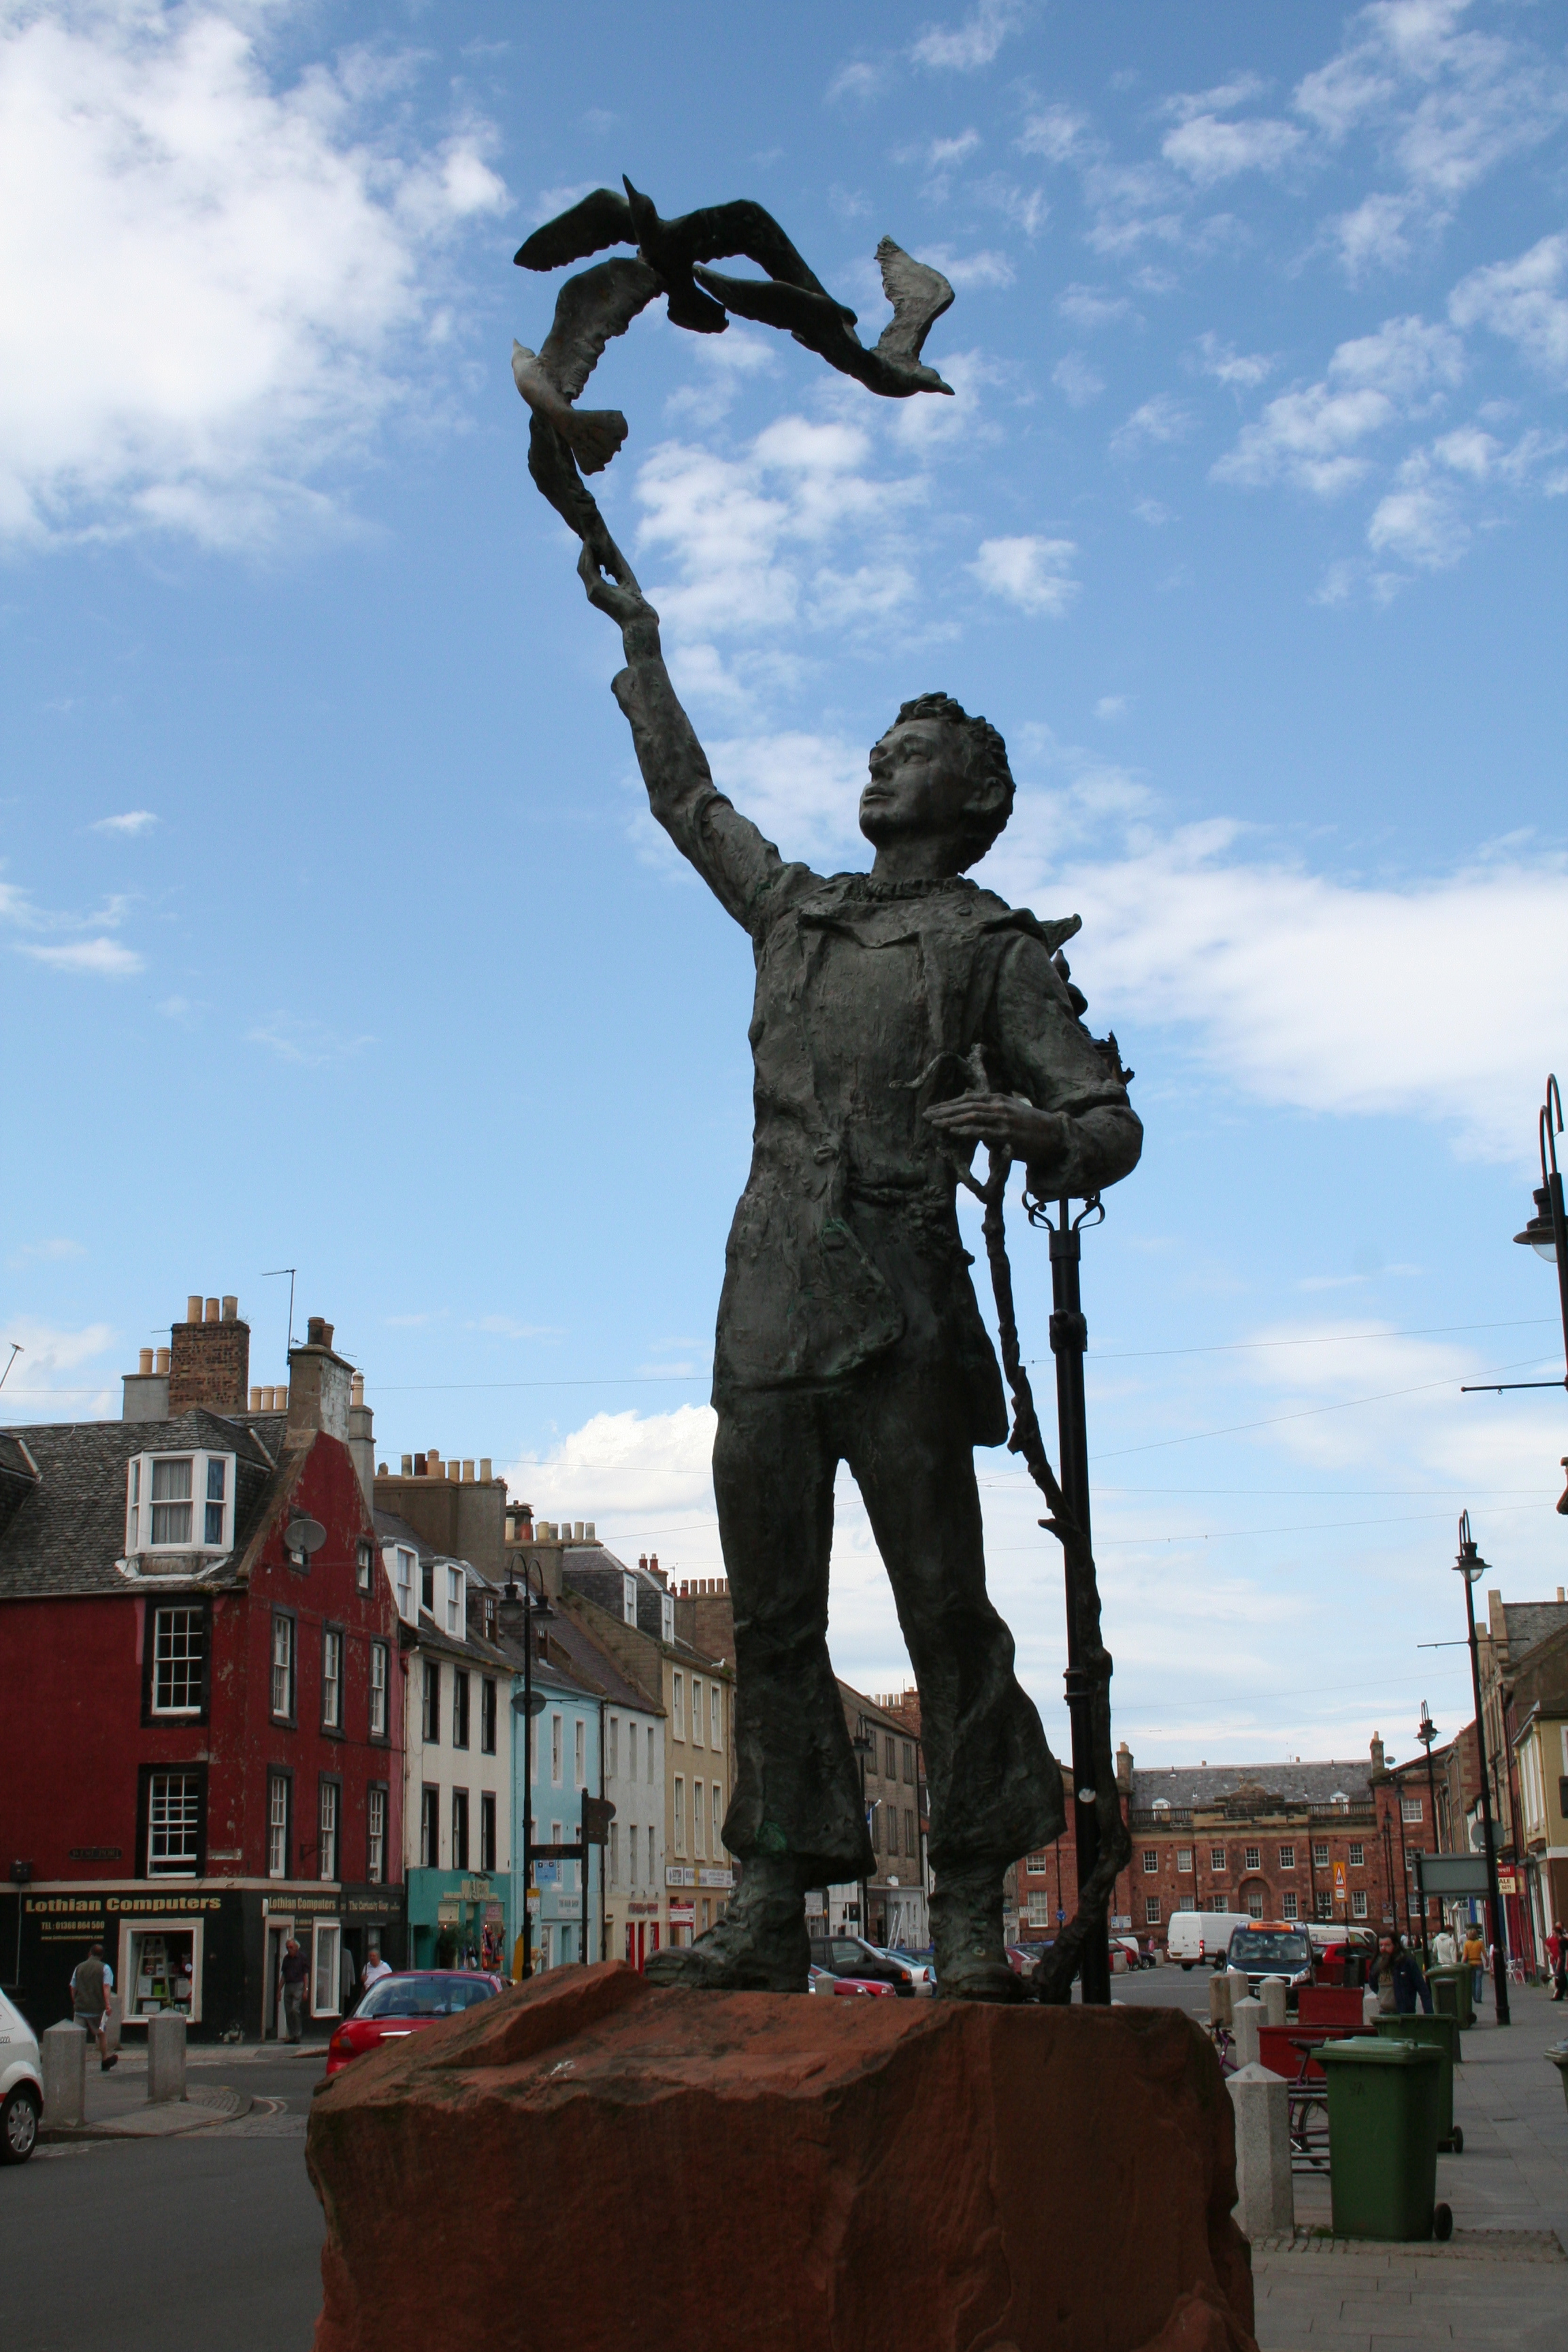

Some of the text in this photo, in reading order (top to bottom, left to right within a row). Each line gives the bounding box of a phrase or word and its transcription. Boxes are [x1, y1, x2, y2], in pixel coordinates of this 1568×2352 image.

[26, 1897, 221, 1912] Lothian Computers
[269, 1897, 296, 1910] Lothian
[297, 1897, 336, 1910] Computers
[348, 1900, 358, 1910] The
[55, 1921, 76, 1930] 01368
[91, 1921, 105, 1929] 500
